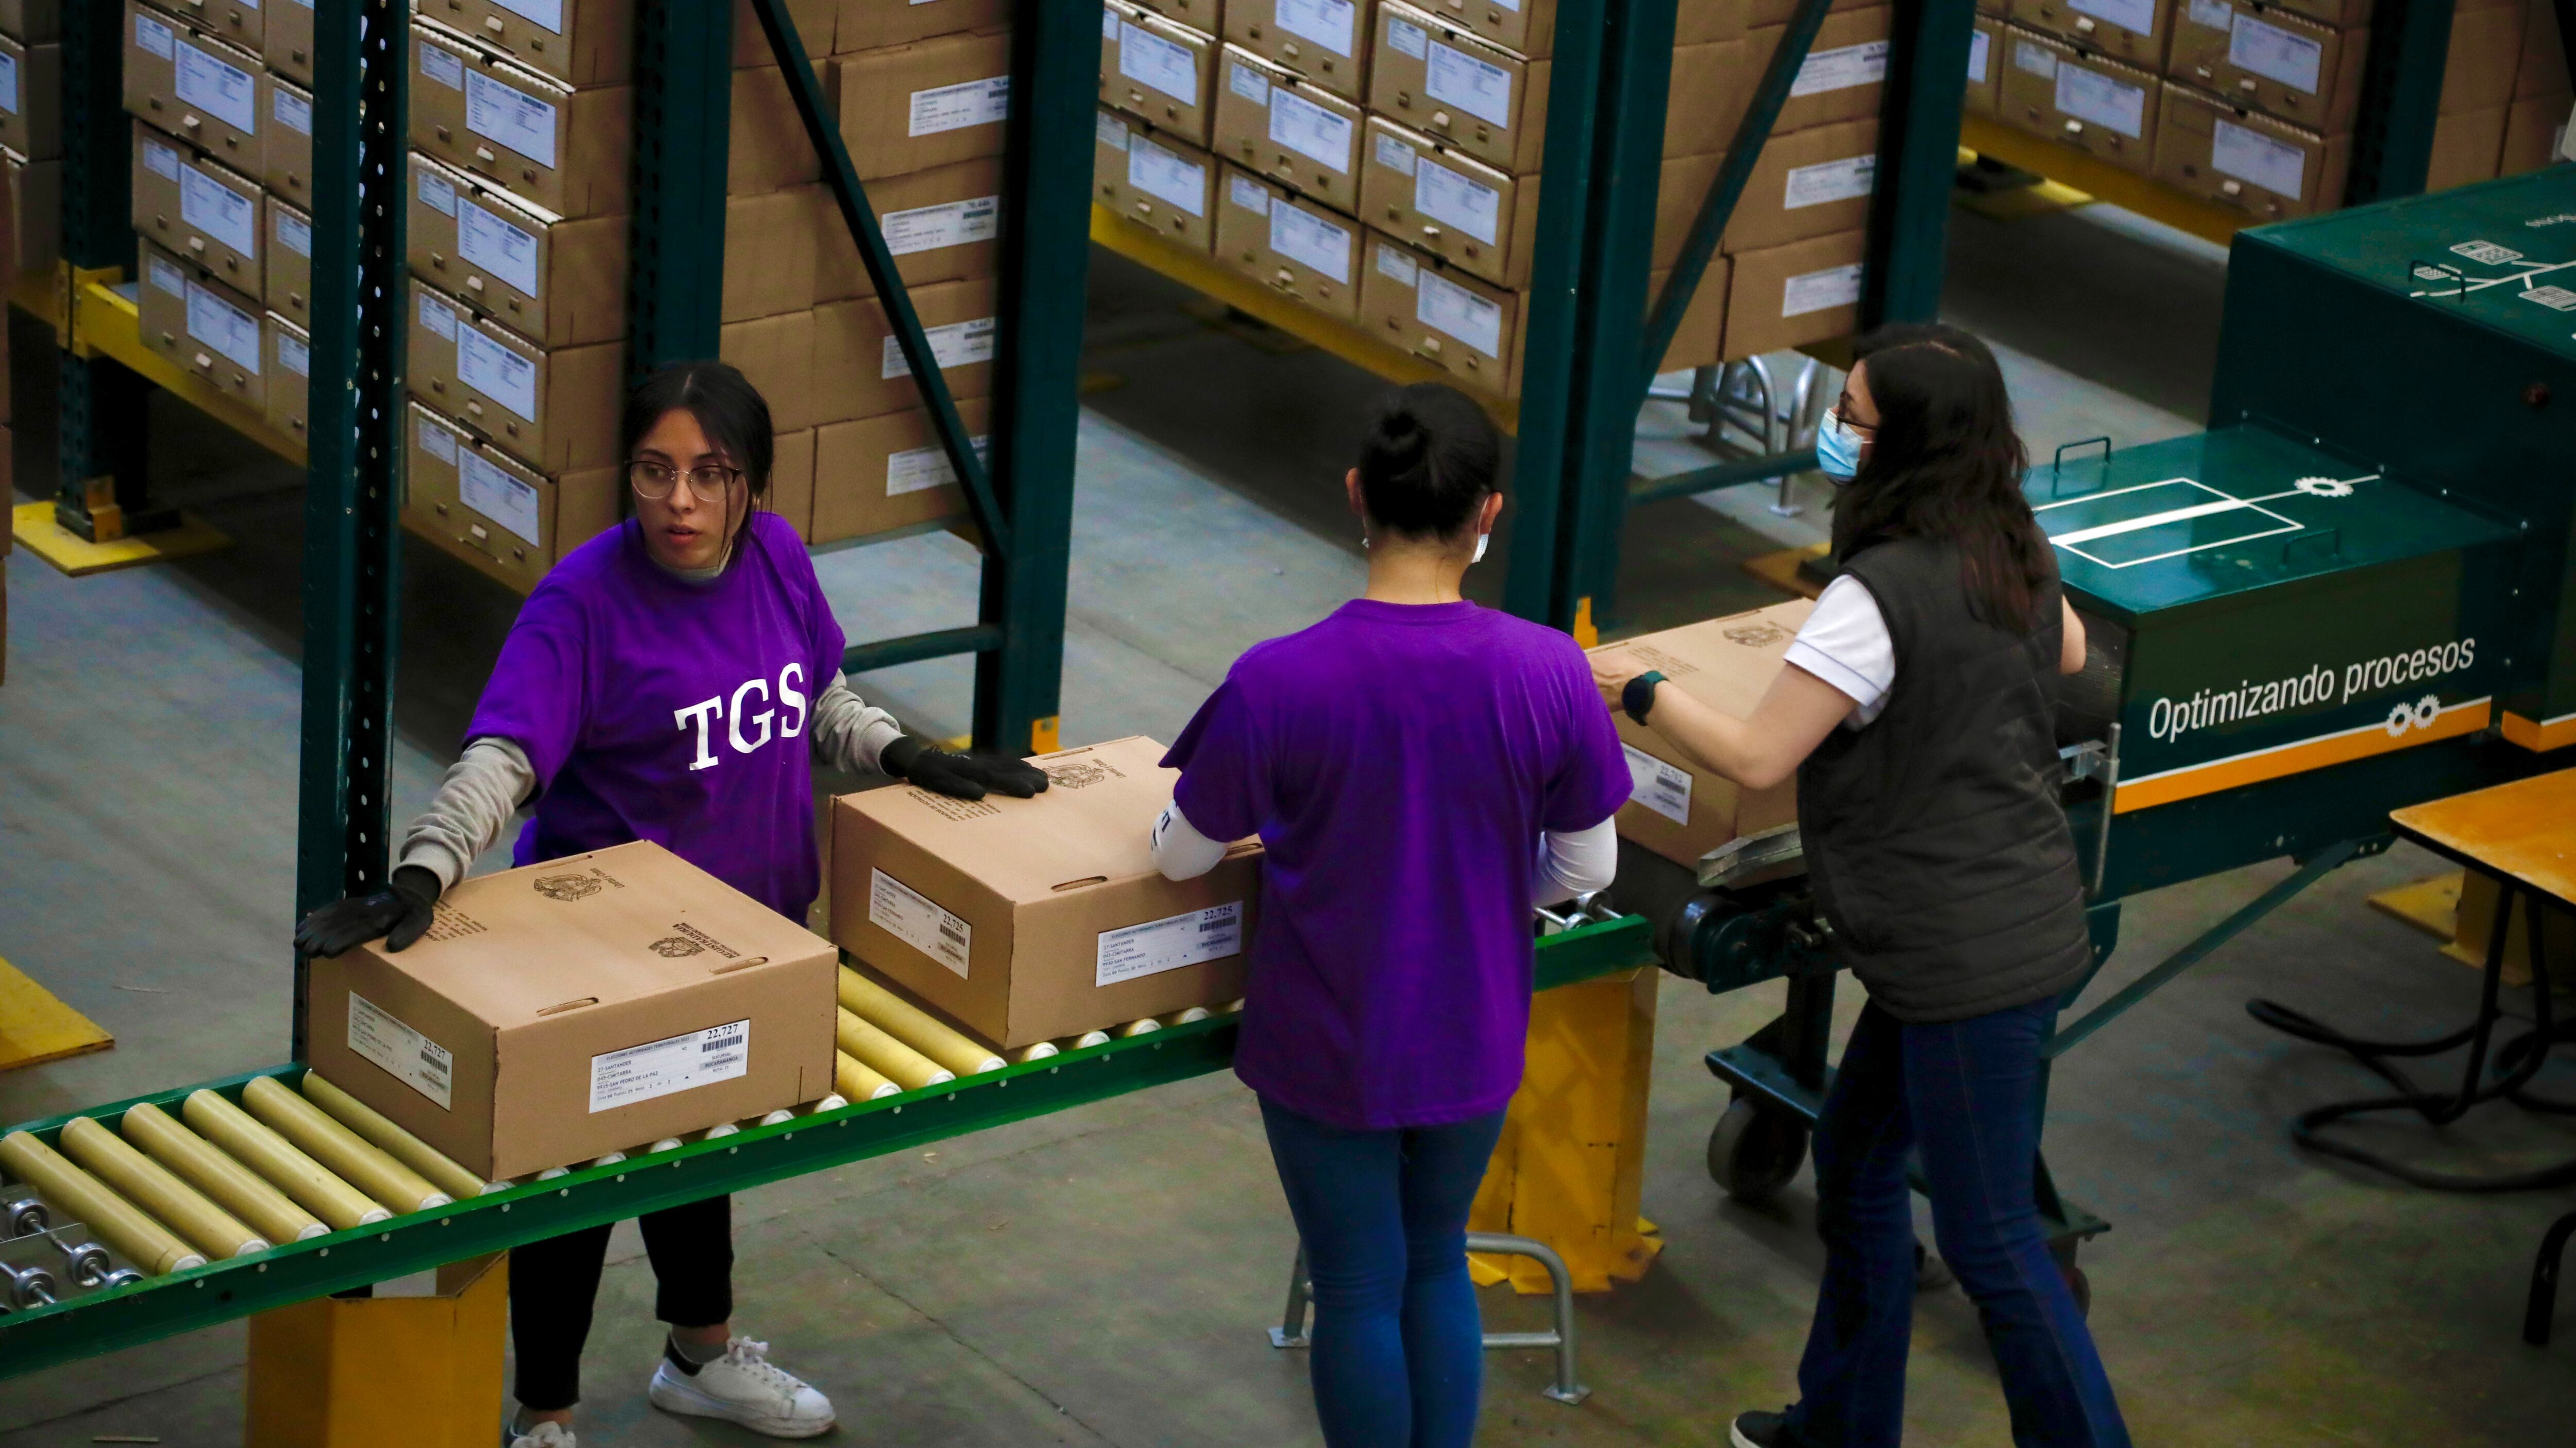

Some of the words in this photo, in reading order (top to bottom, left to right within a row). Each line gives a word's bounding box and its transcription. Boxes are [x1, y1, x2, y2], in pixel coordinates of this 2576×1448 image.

[2149, 664, 2334, 743] Optimizando
[2343, 637, 2475, 703] procesos
[674, 663, 806, 771] TGS
[1204, 905, 1232, 920] 22,725
[943, 914, 963, 933] 22,725
[707, 1023, 738, 1039] 22,727
[424, 1039, 445, 1059] 22,727
[598, 1059, 631, 1072] 27-SANTANDER
[705, 1055, 738, 1068] BUCARAMANGA
[597, 1069, 631, 1082] 045-CIMITARRA
